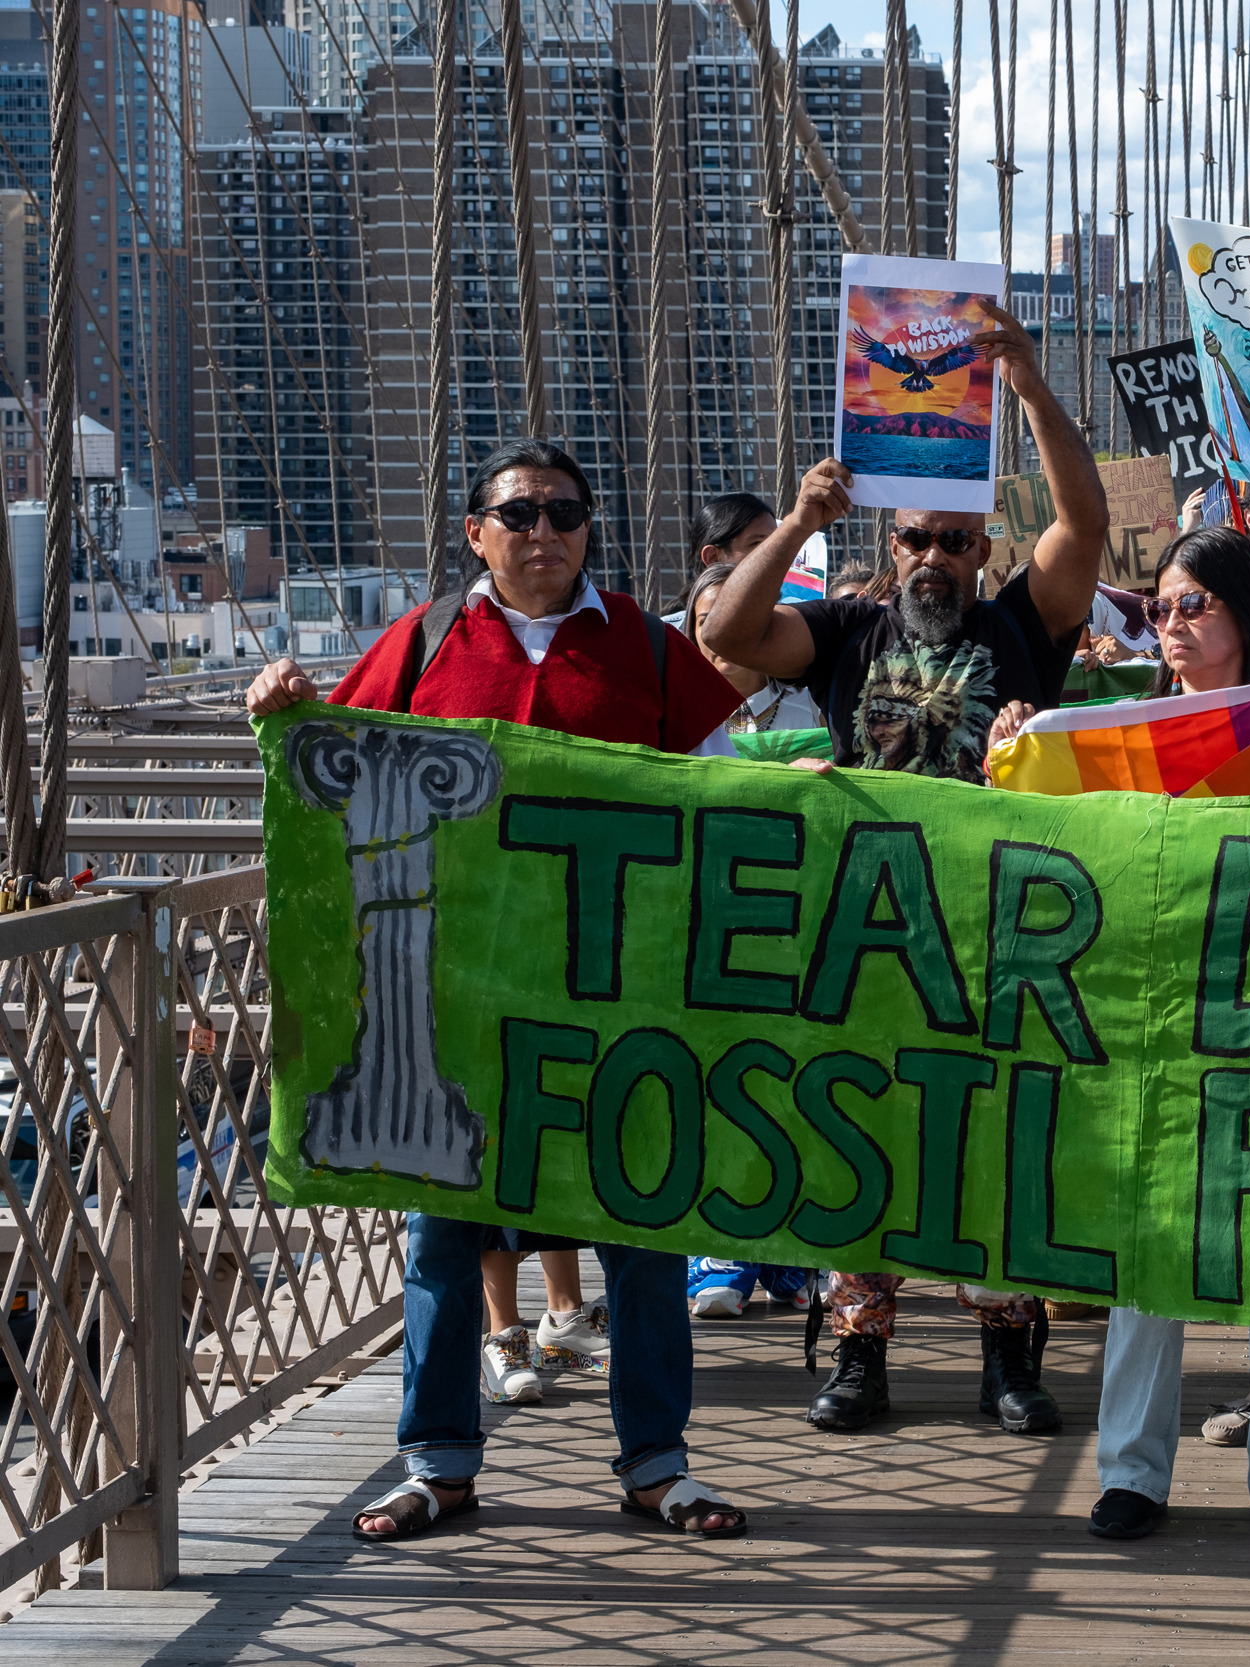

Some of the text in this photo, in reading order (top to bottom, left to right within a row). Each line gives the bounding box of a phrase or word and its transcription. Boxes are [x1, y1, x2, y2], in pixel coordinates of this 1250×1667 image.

[885, 328, 970, 358] TO WISDOM
[907, 315, 953, 337] BACK
[499, 795, 1108, 1066] TEAR
[495, 1017, 1117, 1298] FOSSIL
